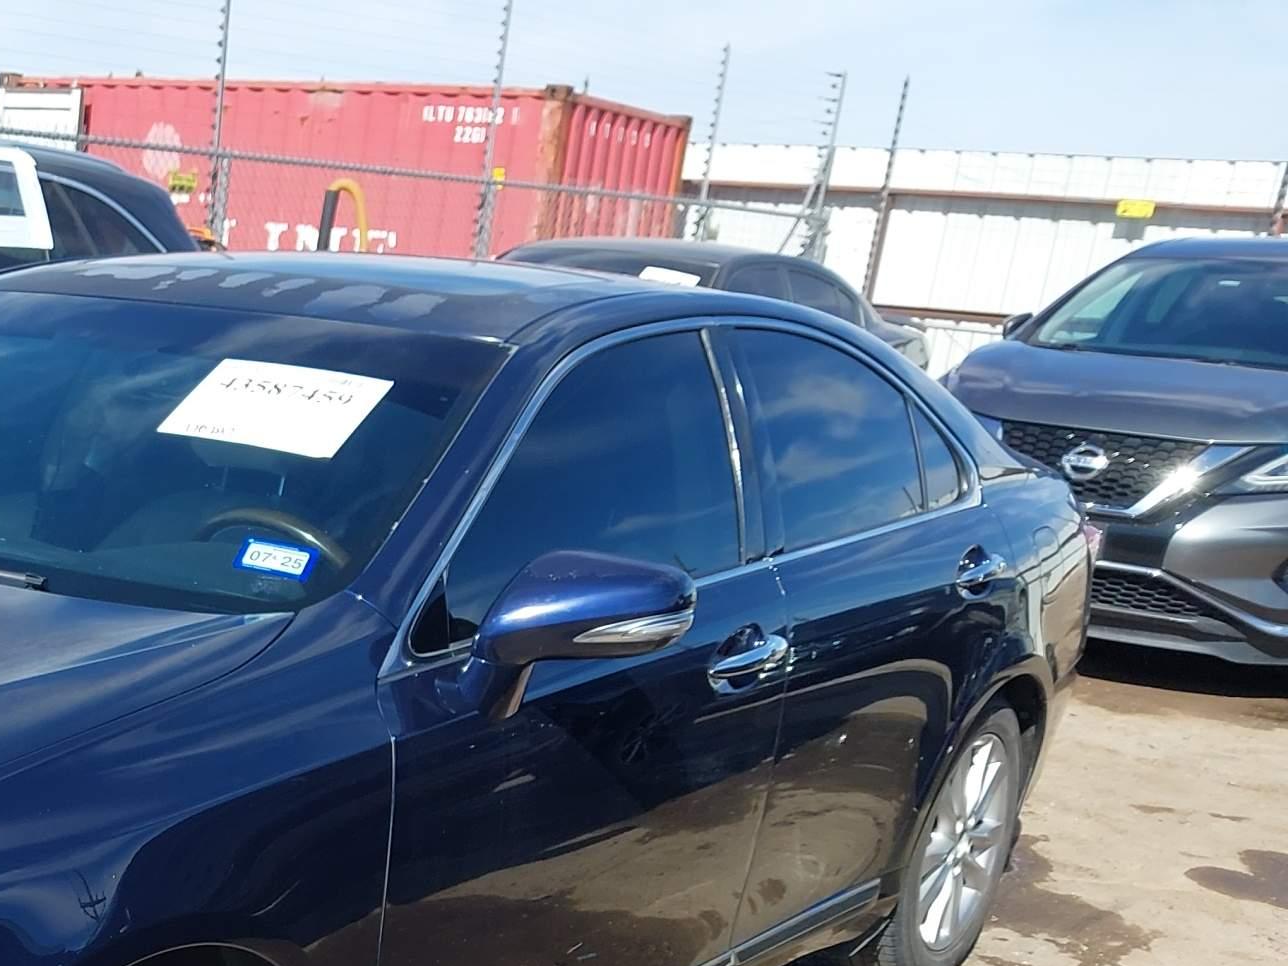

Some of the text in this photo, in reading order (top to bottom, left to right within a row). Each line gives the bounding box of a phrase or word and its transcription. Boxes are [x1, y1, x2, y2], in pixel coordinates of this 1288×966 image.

[220, 376, 355, 406] 43587459
[249, 550, 305, 570] 07 25
